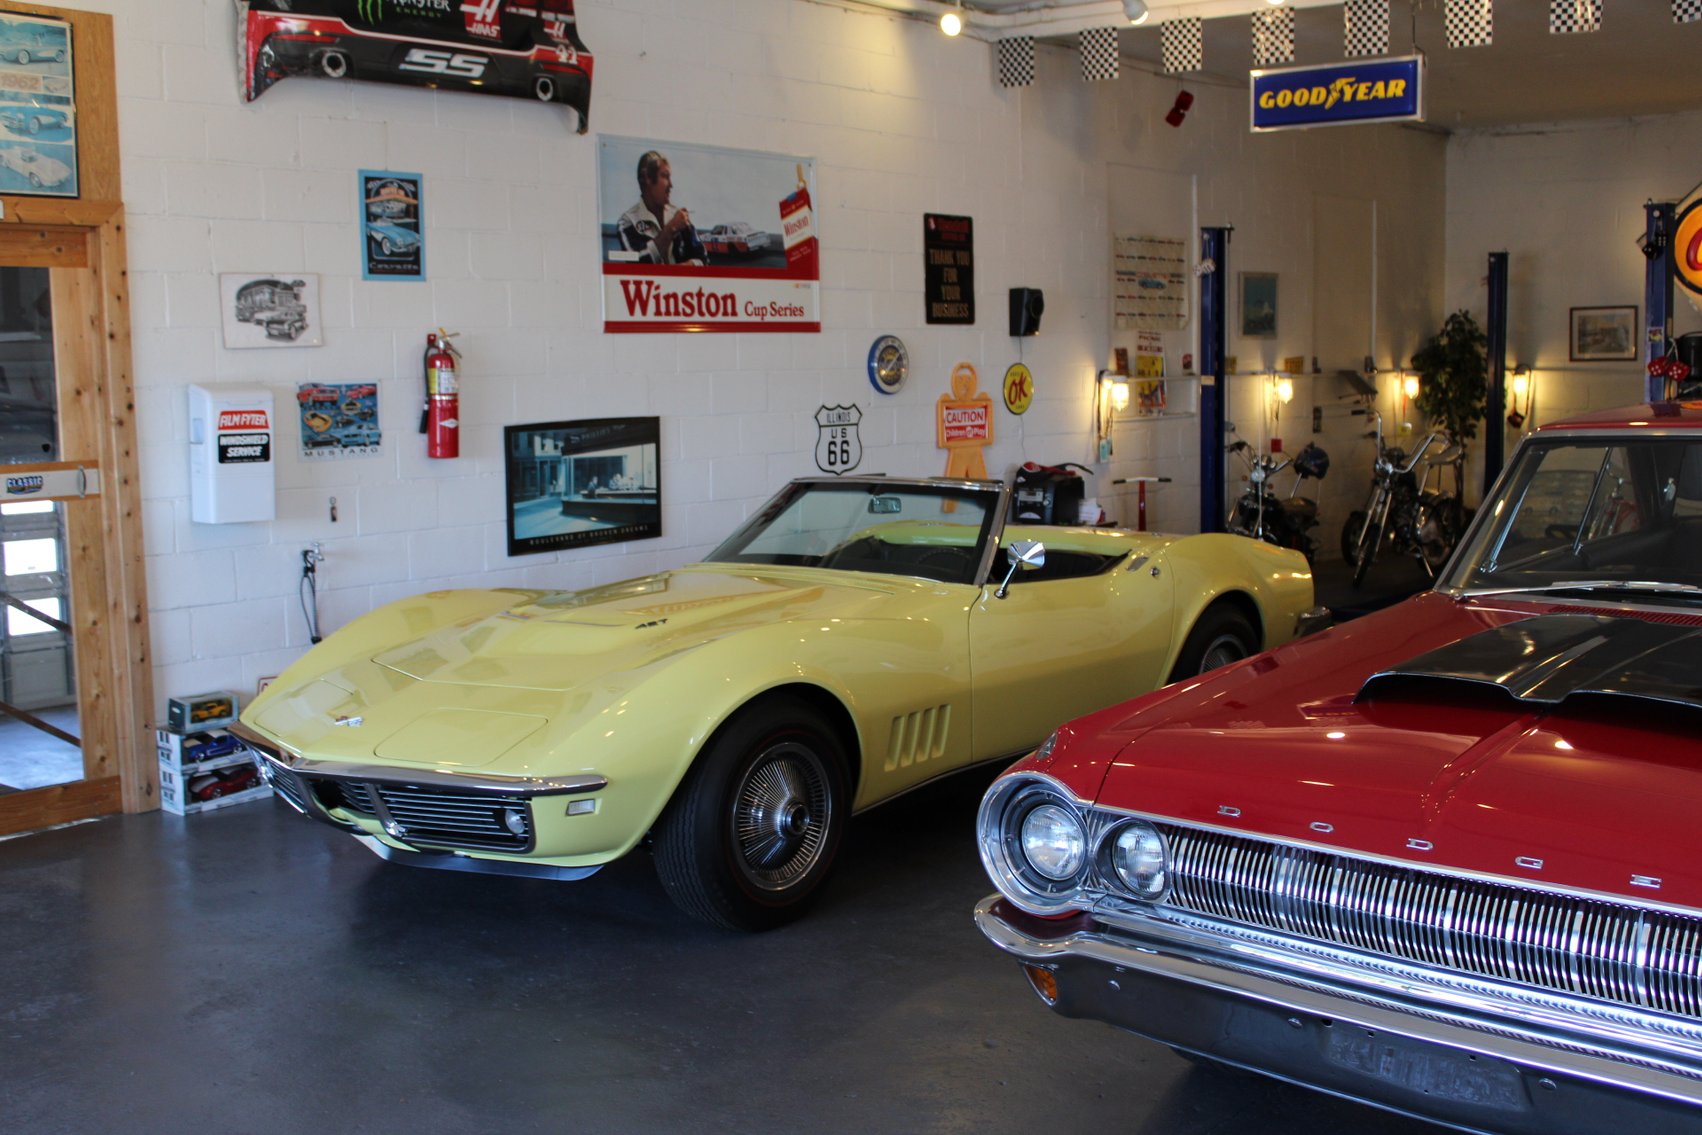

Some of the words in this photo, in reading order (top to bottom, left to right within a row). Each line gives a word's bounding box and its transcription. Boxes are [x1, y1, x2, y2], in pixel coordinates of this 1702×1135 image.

[398, 49, 489, 78] SS
[556, 45, 578, 64] 41
[620, 279, 738, 317] Winston
[744, 300, 769, 321] Cup
[770, 301, 805, 317] Series
[1008, 371, 1029, 406] OK
[826, 411, 851, 424] ILLINOIS
[946, 410, 984, 424] CAUTION
[226, 446, 263, 457] SERVICE
[304, 447, 378, 457] MUSTANG
[827, 440, 850, 466] 66
[7, 475, 44, 488] CLASSIC
[1216, 804, 1662, 889] DODGE
